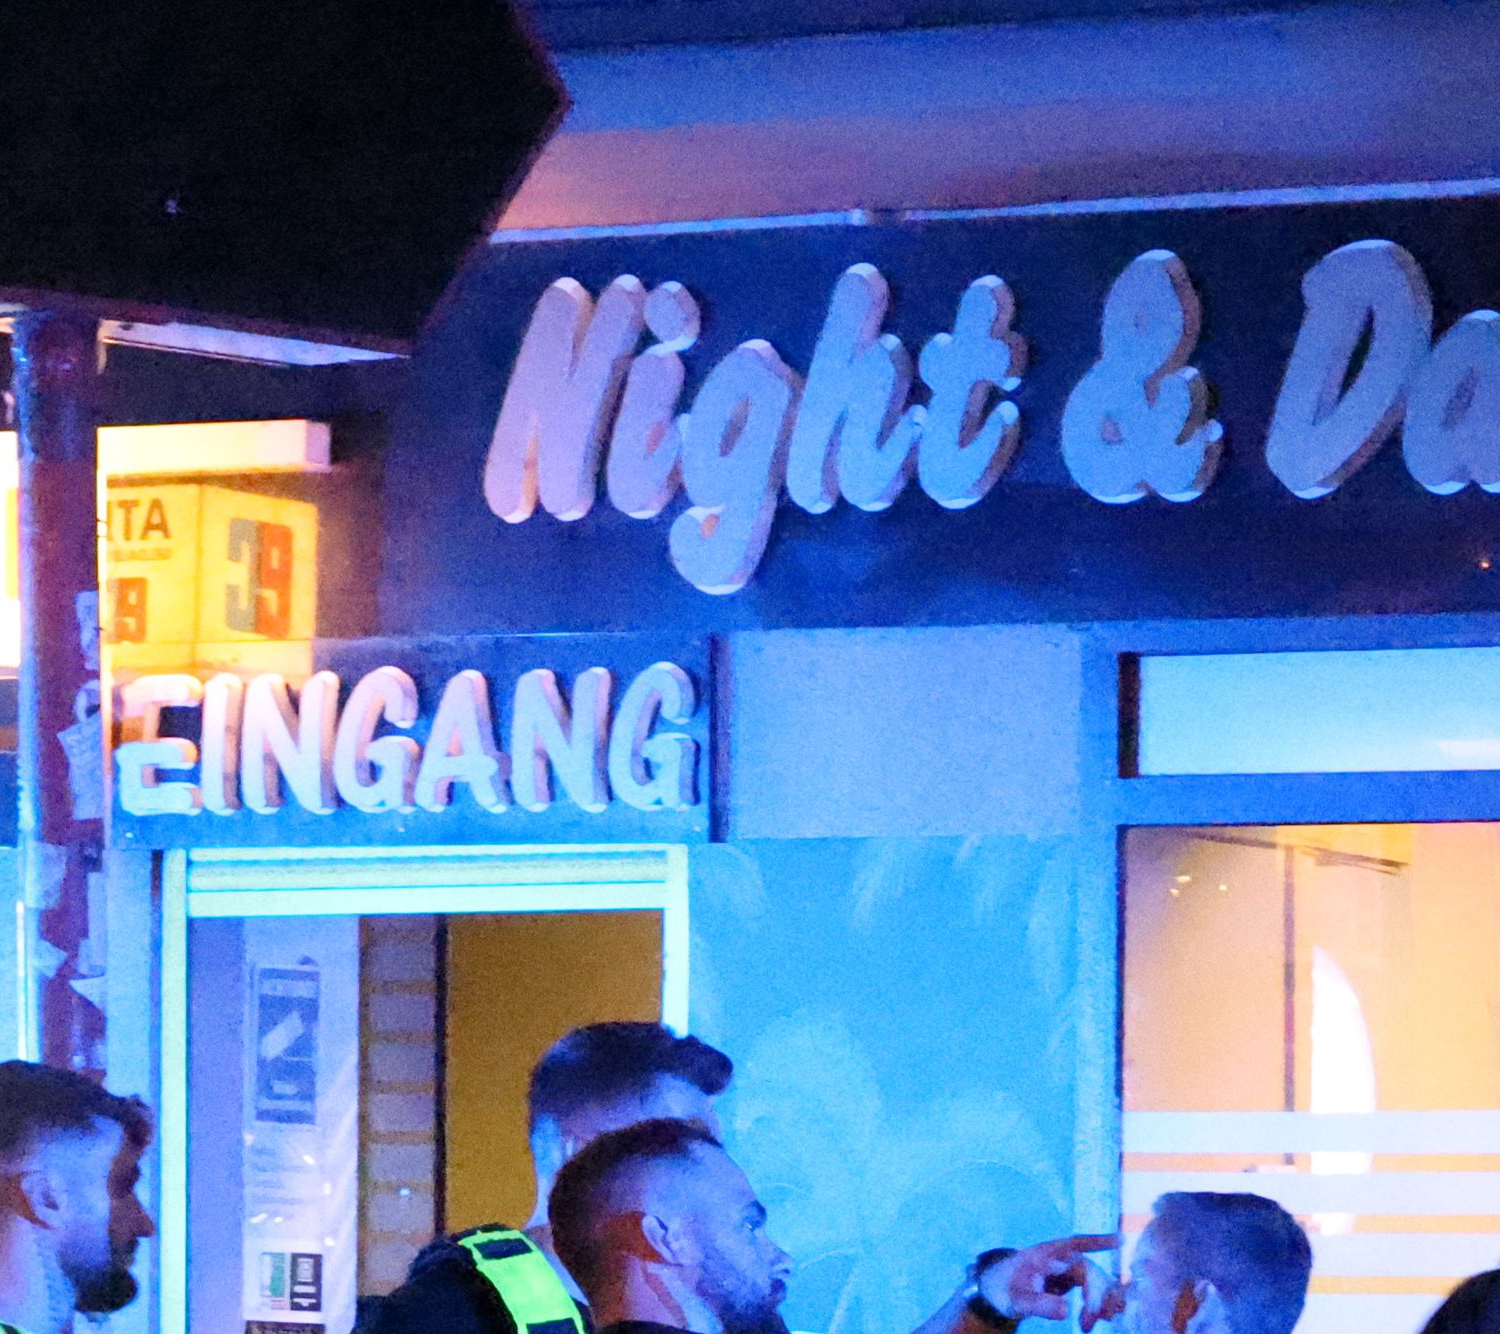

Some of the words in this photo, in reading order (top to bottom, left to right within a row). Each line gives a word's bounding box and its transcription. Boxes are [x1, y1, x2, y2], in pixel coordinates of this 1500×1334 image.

[482, 260, 1028, 595] Night
[1061, 249, 1223, 502] &
[113, 661, 701, 816] EINGANG
